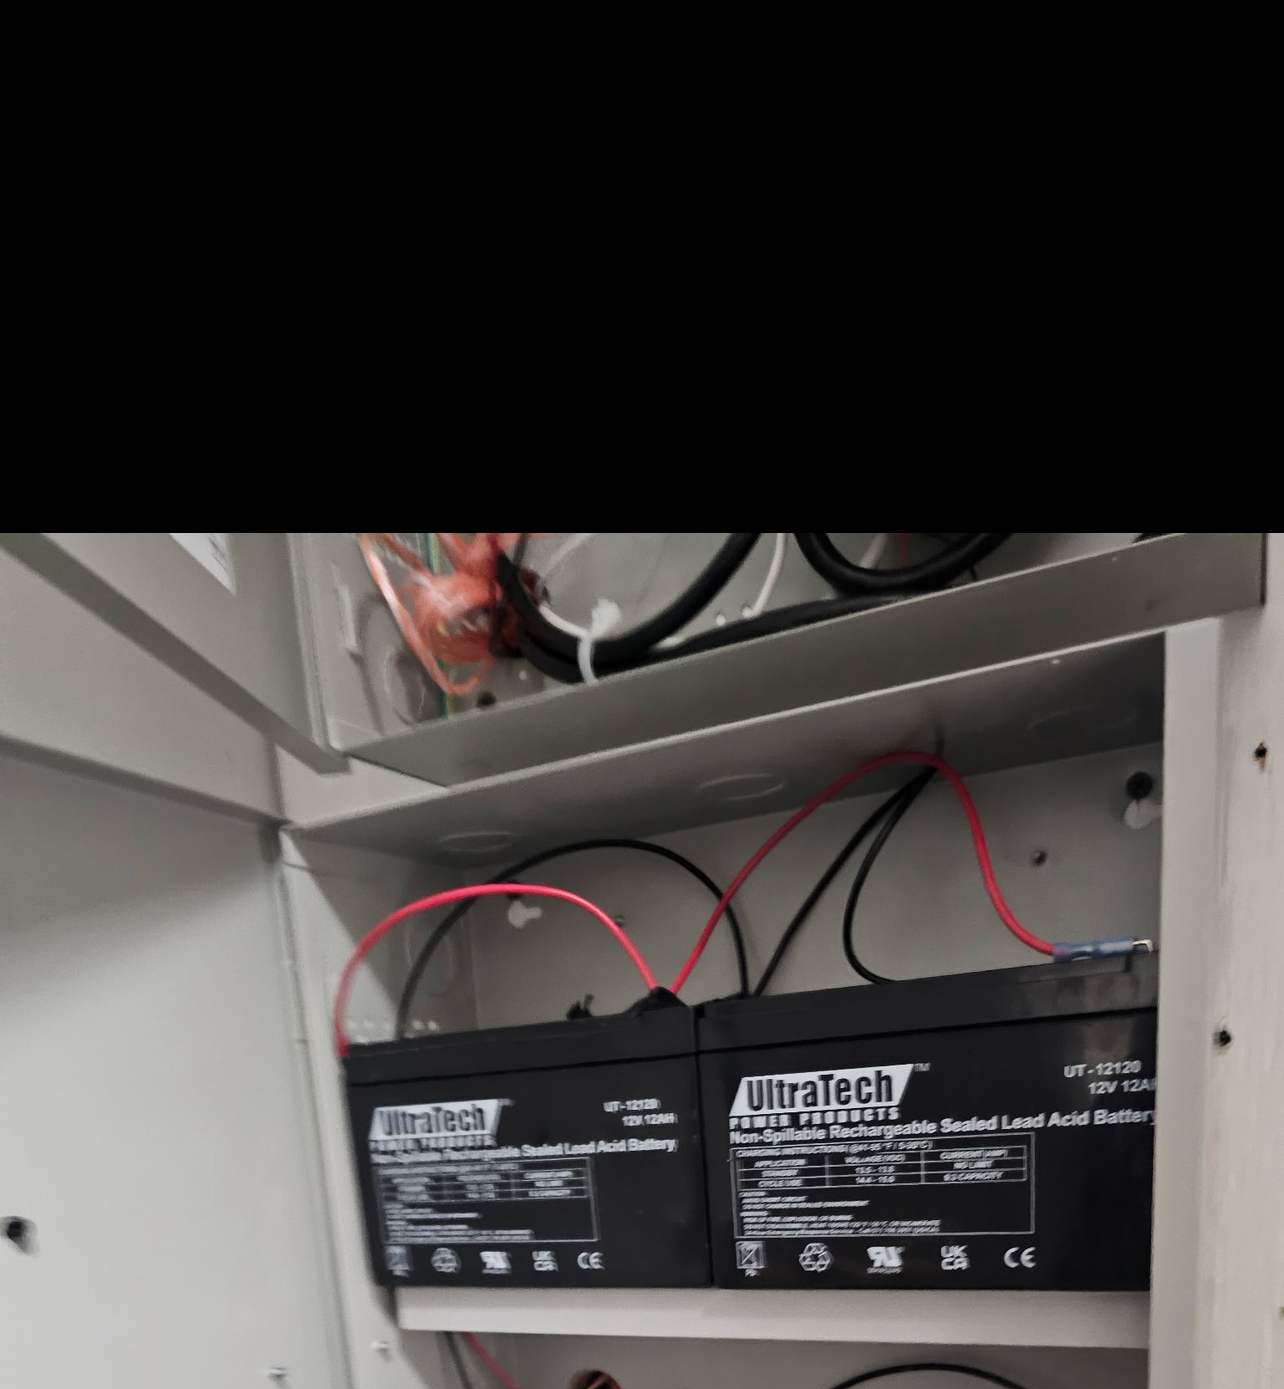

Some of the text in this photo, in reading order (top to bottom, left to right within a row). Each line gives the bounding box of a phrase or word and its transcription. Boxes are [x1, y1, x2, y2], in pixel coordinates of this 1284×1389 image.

[747, 1070, 893, 1111] UltraTech
[1088, 1080, 1118, 1095] 12V
[380, 1103, 485, 1136] UltraTech
[645, 1112, 678, 1125] 12AH
[729, 1107, 900, 1130] POWER PRODUCTS
[730, 1127, 827, 1146] Non-Spillable
[829, 1119, 938, 1140] Rechargeable
[940, 1115, 998, 1134] Sealed
[1001, 1112, 1045, 1130] Lead
[1047, 1110, 1091, 1127] Acid
[564, 1141, 596, 1155] Lead
[597, 1139, 627, 1152] Acid
[627, 1138, 678, 1152] Battery
[1004, 1247, 1036, 1269] CE
